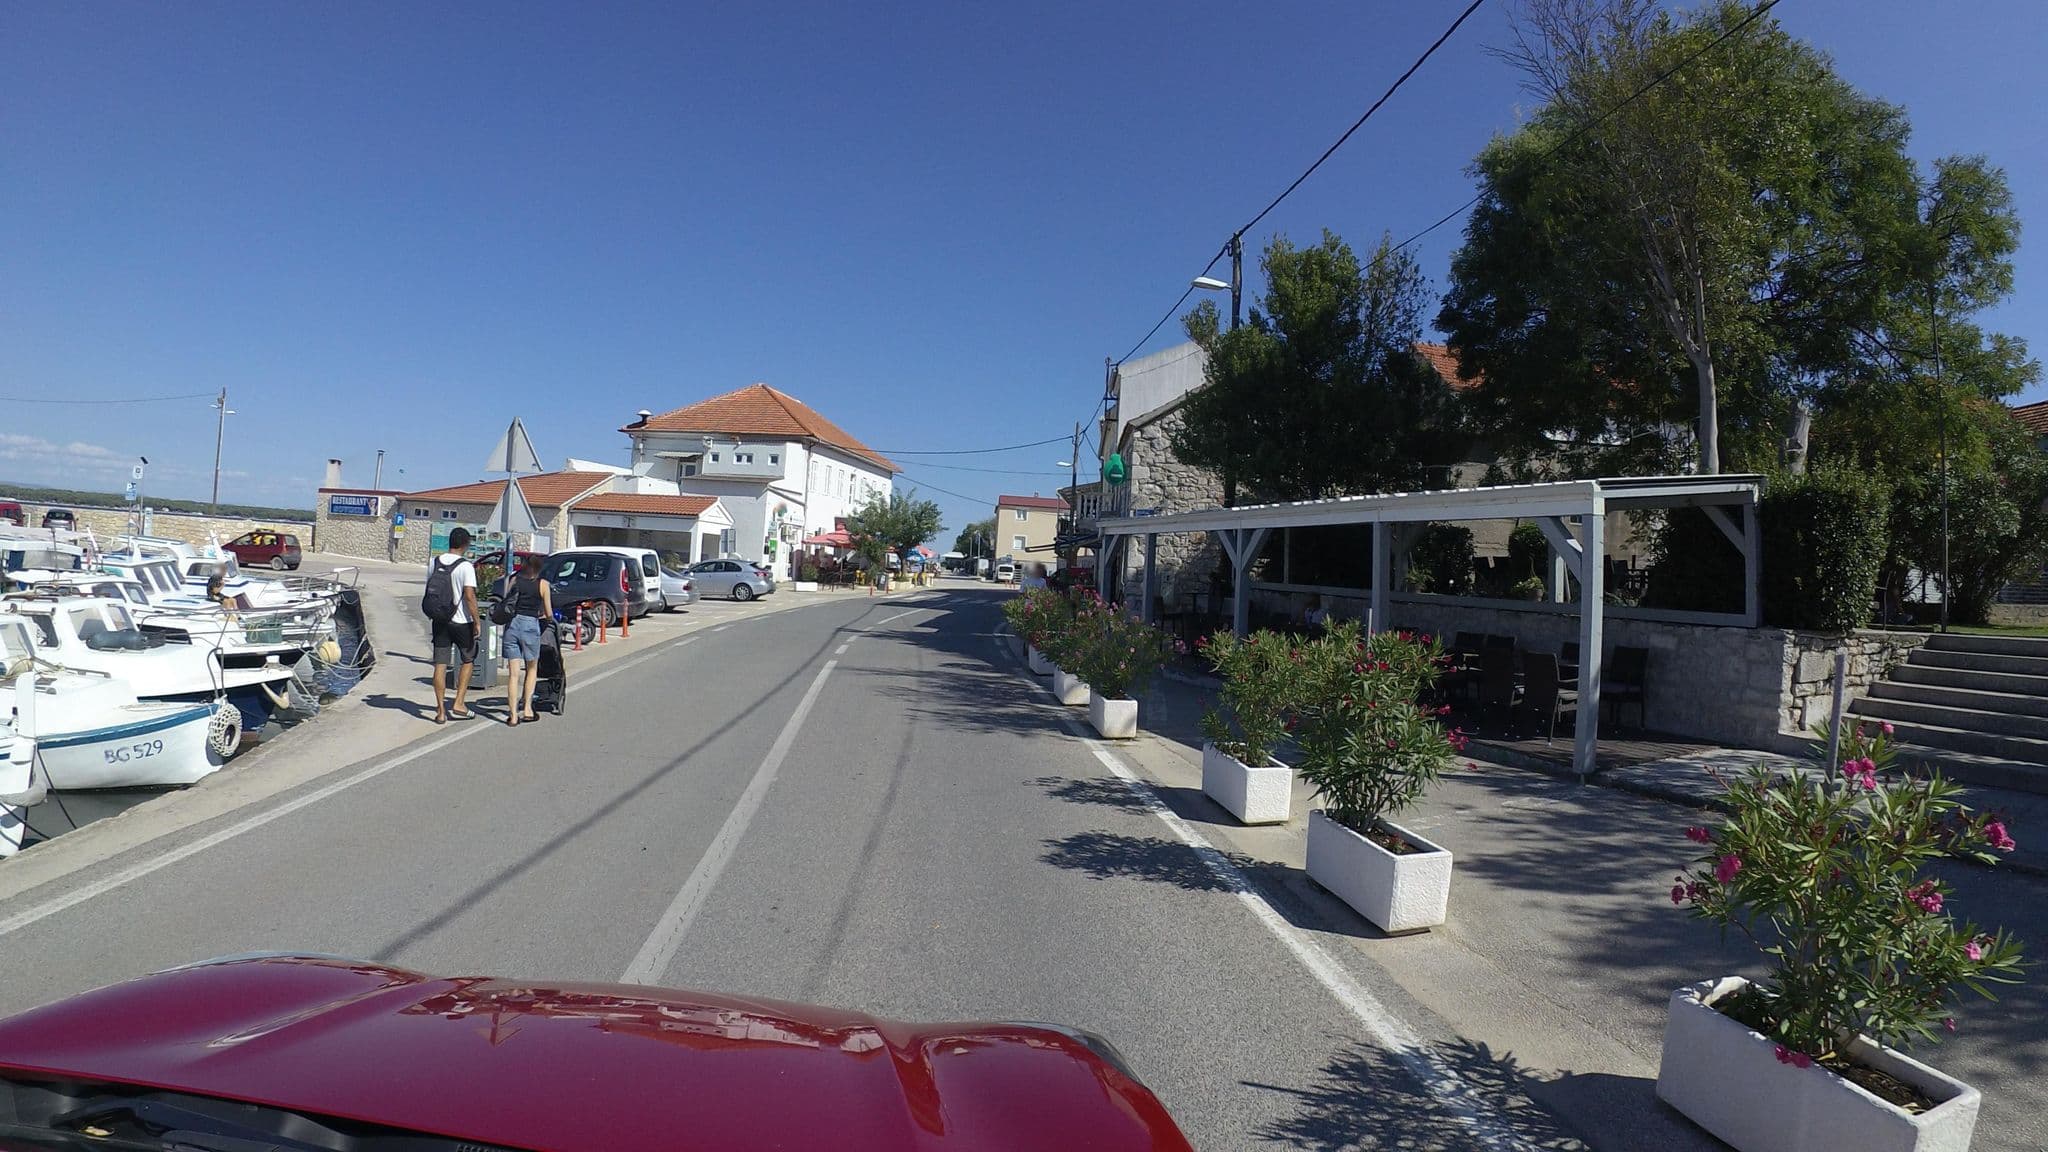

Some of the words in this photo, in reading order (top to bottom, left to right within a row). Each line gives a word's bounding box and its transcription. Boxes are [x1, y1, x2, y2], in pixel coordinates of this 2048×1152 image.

[332, 496, 368, 506] RESTAURANT
[104, 747, 130, 763] BG
[133, 739, 163, 759] 529
